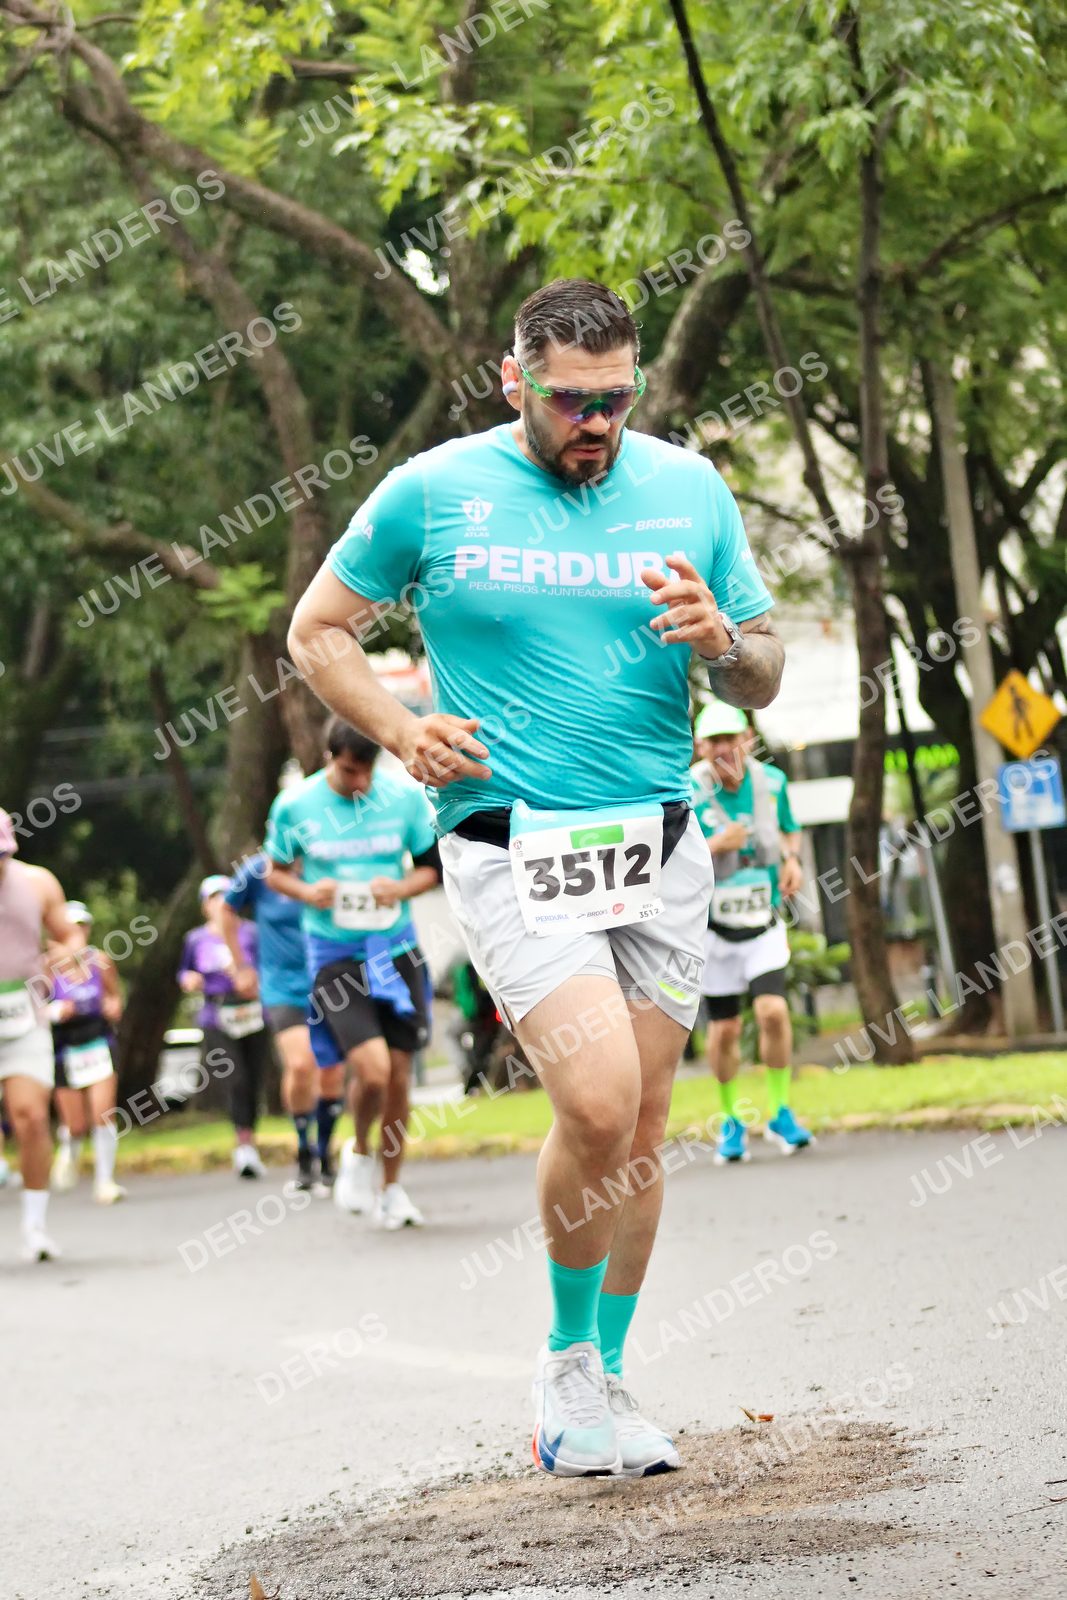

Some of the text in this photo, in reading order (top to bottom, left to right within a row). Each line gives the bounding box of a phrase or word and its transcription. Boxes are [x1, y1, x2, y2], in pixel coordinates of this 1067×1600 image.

[634, 516, 693, 531] BROOKS
[469, 581, 500, 591] PEGA
[503, 584, 538, 594] PISOS
[548, 587, 632, 598] JUNTEADORES
[523, 843, 652, 902] 3512
[341, 894, 395, 912] 52
[535, 913, 570, 923] PERDURA
[639, 908, 660, 919] 3512
